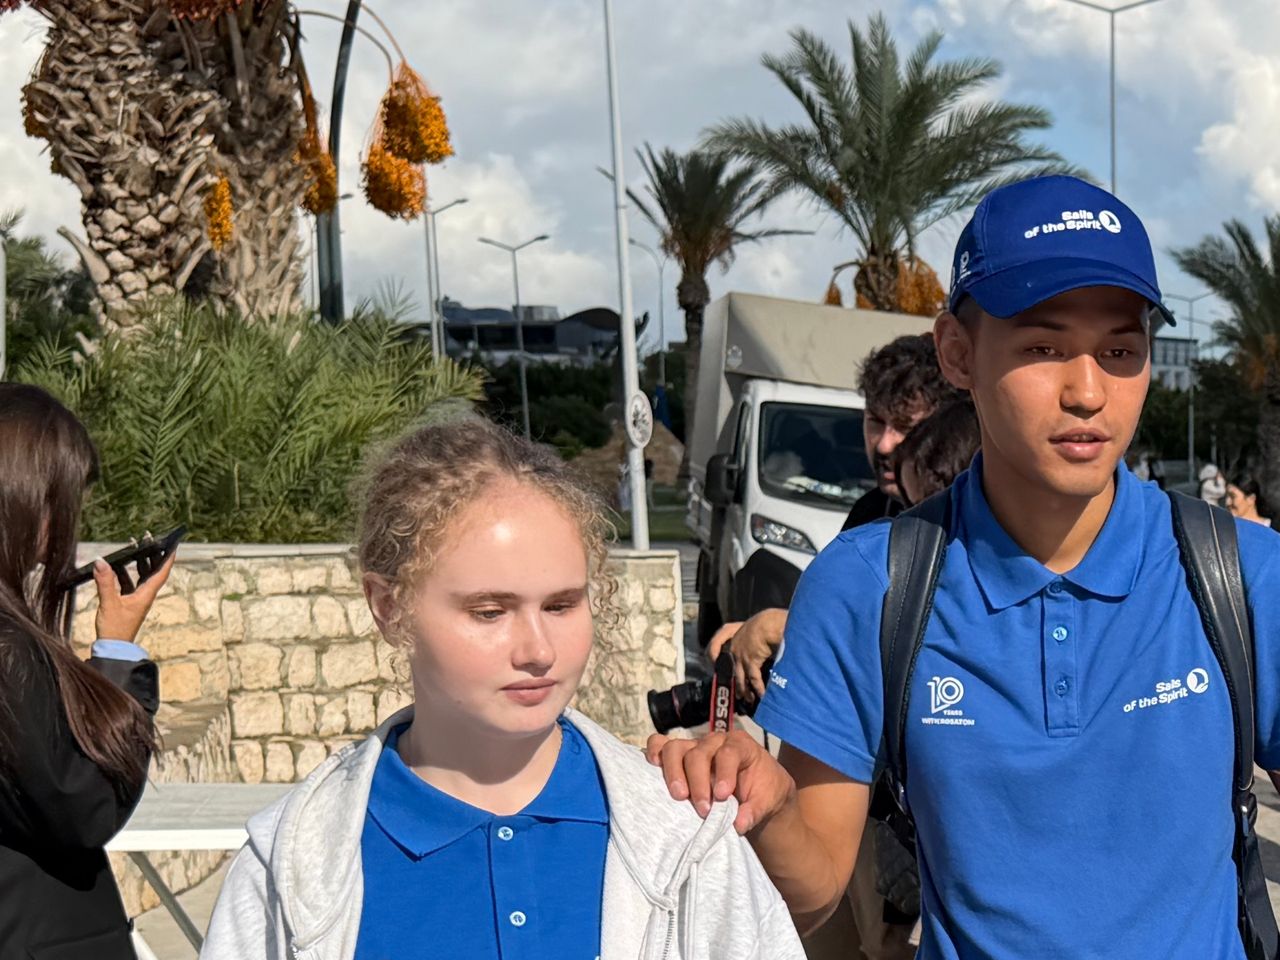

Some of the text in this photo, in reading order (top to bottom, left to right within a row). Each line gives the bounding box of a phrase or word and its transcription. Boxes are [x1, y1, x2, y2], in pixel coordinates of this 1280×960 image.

[1062, 209, 1094, 220] Sails
[1024, 219, 1102, 238] of the Spirit
[1155, 679, 1181, 693] Sails
[716, 686, 730, 718] EOS
[1123, 687, 1189, 713] of the Spirit
